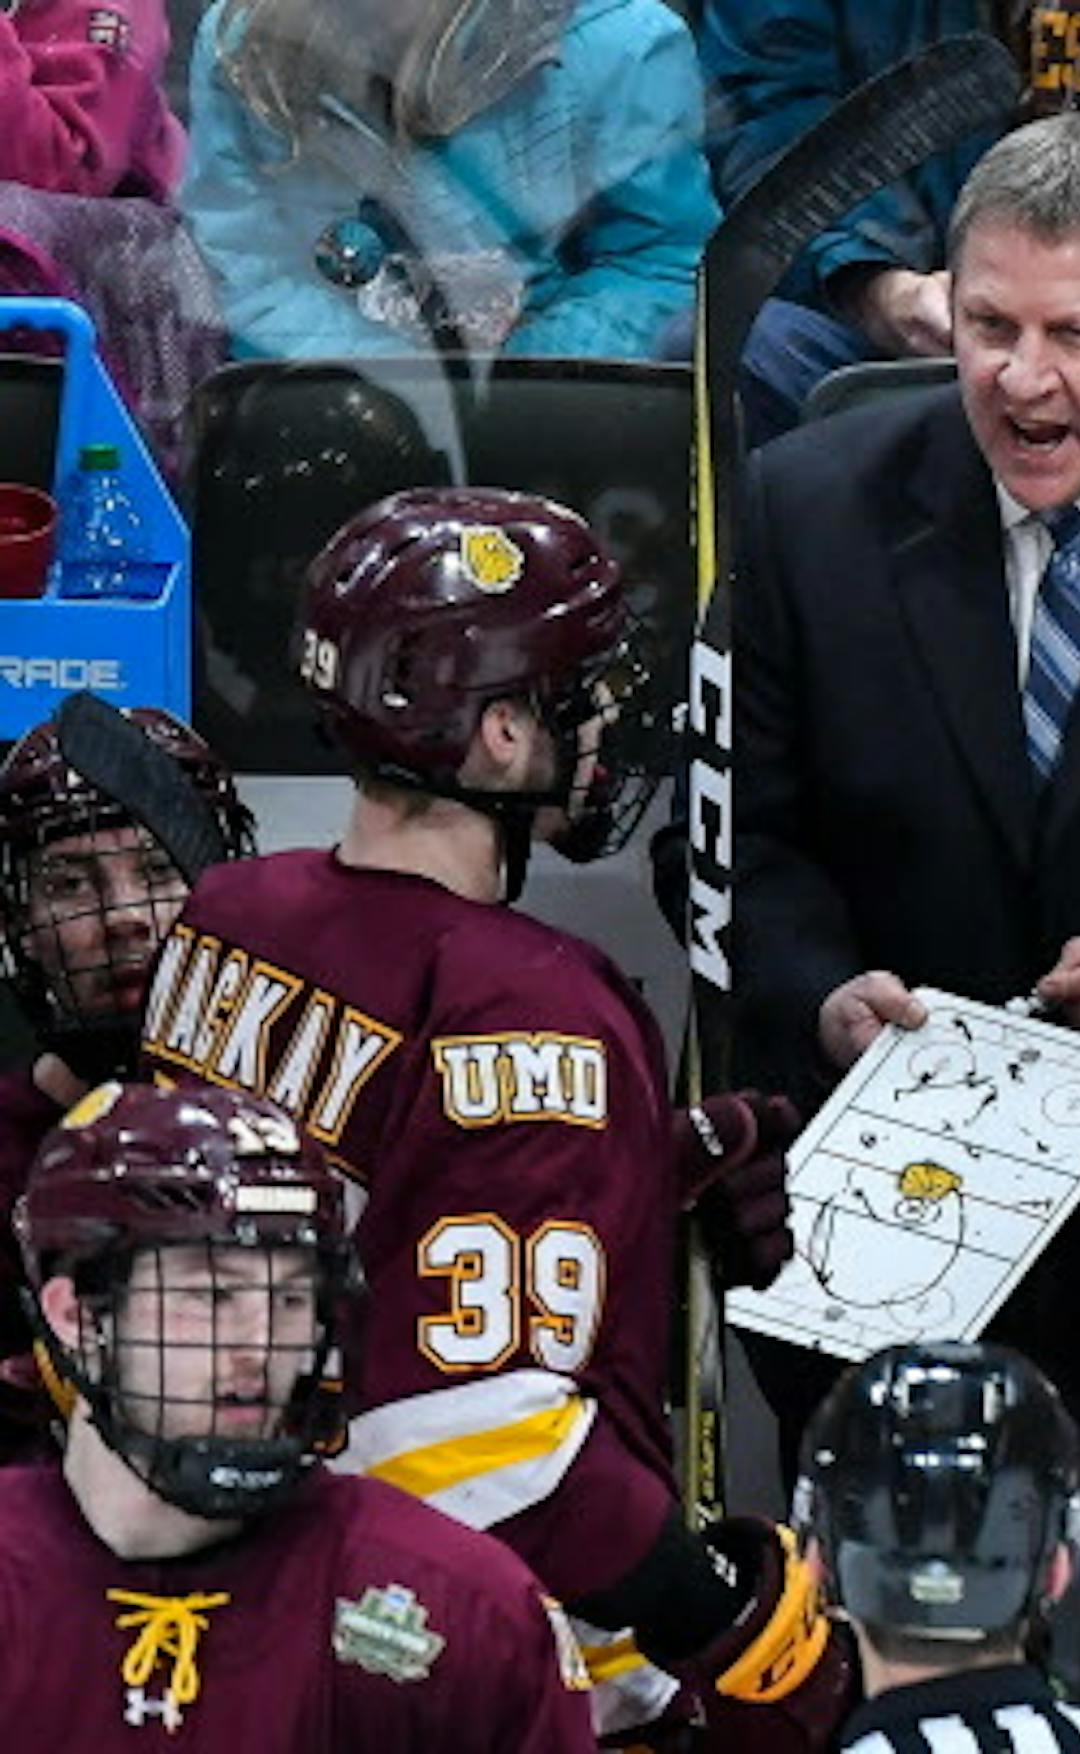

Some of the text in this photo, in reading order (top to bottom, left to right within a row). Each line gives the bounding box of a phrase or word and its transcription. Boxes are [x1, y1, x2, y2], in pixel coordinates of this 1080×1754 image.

[300, 629, 340, 690] 39
[689, 639, 733, 994] CCM
[430, 1032, 608, 1130] UMD
[417, 1212, 607, 1374] 39
